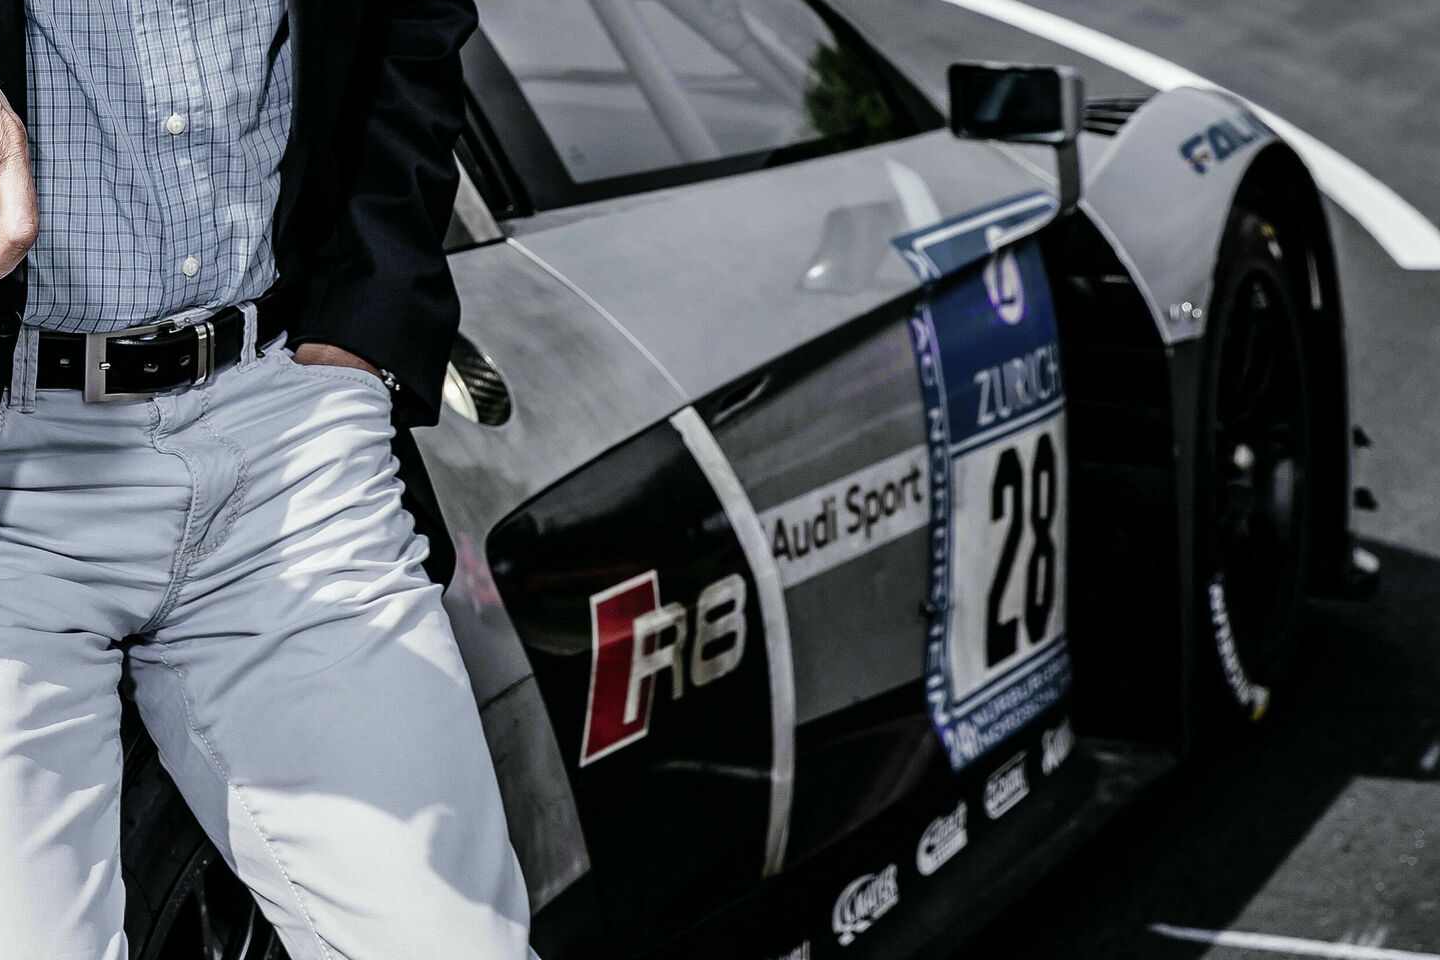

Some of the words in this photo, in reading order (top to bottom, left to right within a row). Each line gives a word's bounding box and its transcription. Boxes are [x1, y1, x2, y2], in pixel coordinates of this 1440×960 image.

[973, 344, 1060, 426] ZURICH
[772, 496, 839, 562] Audi
[845, 464, 923, 539] Sport
[985, 432, 1057, 668] 28
[610, 571, 748, 734] R8
